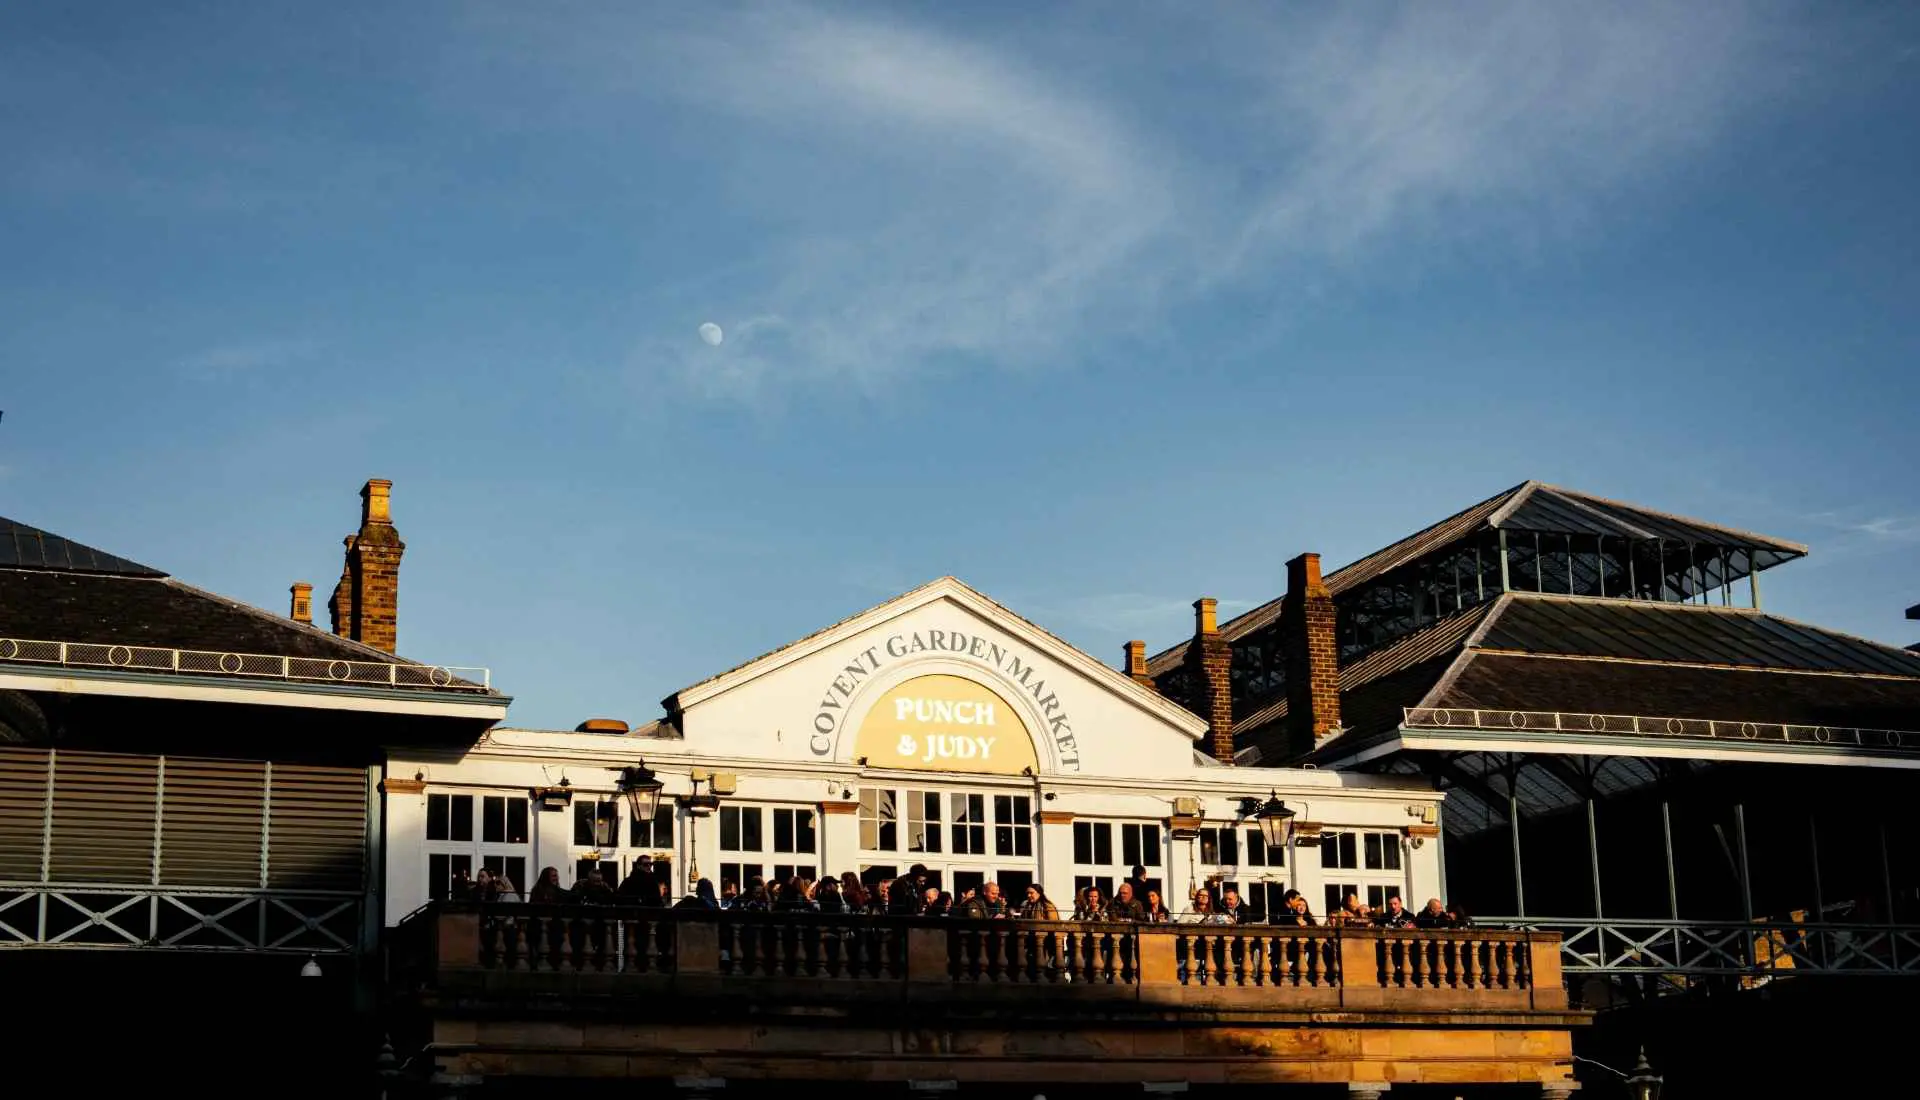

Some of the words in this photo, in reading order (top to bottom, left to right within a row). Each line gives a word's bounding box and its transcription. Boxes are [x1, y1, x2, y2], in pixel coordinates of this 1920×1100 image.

[810, 647, 882, 756] COVENT
[886, 630, 1007, 668] GARDEN
[1006, 656, 1080, 771] MARKET
[895, 698, 995, 725] PUNCH
[897, 734, 917, 756] &
[922, 735, 996, 762] JUDY
